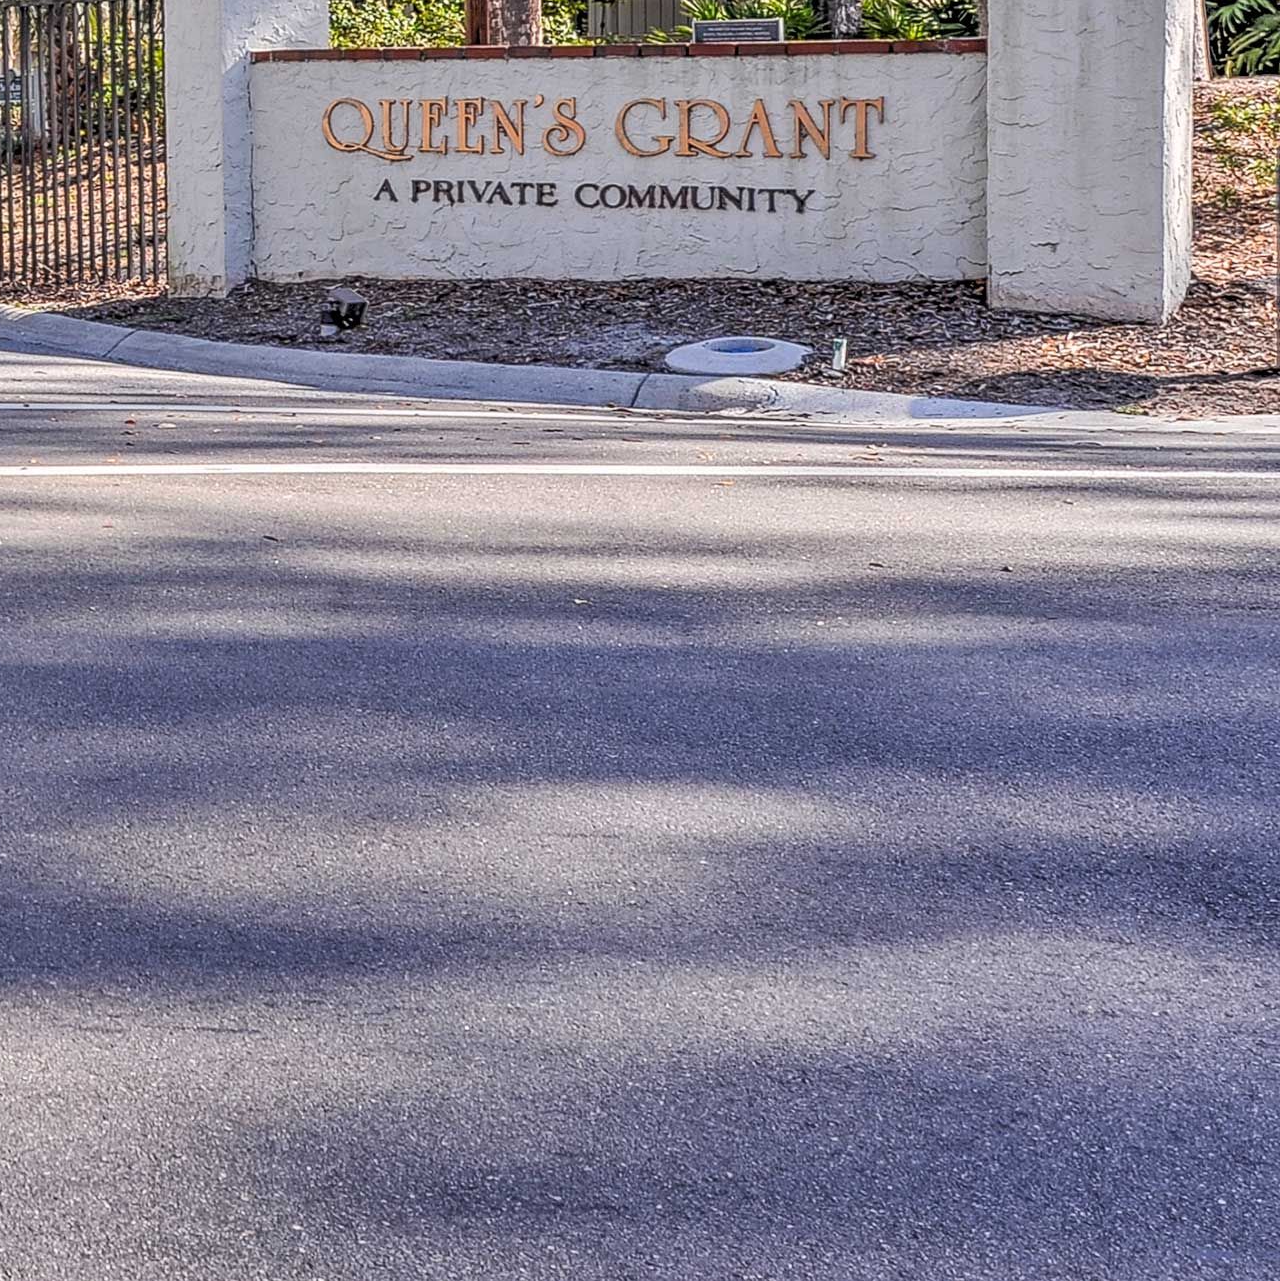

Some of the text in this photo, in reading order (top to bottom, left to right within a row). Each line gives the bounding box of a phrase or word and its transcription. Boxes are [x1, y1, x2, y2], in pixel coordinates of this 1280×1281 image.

[322, 94, 885, 161] QUEEN'S GRANT
[373, 178, 816, 213] A PRIVATE COMMUNITY
